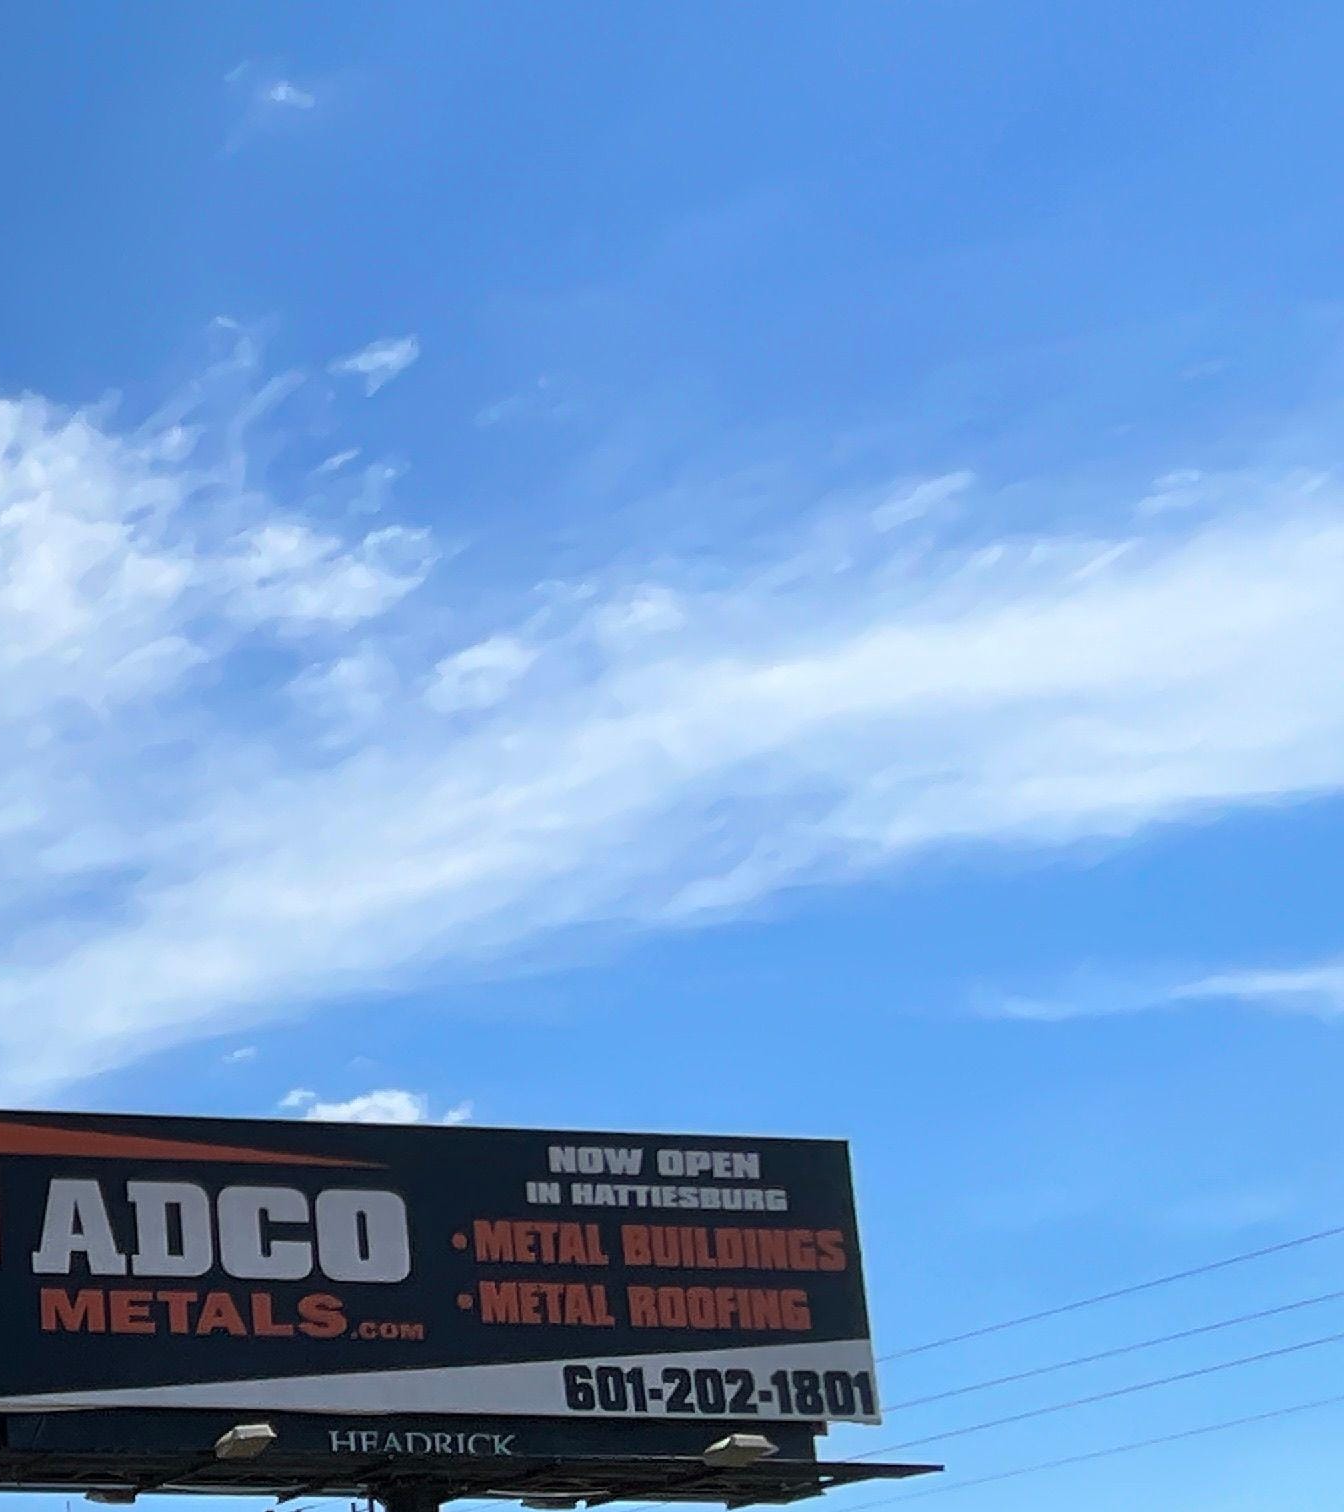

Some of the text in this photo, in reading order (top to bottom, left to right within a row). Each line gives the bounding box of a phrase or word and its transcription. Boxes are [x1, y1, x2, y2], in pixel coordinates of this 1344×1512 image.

[548, 1146, 760, 1179] NOW OPEN
[526, 1181, 788, 1212] IN HATTIESBURG
[32, 1178, 410, 1284] ADCO
[473, 1220, 847, 1272] METAL BUILDINGS
[479, 1281, 812, 1331] METAL ROOFING
[563, 1364, 876, 1416] 601-202-1801
[328, 1431, 516, 1456] HEADRICK
